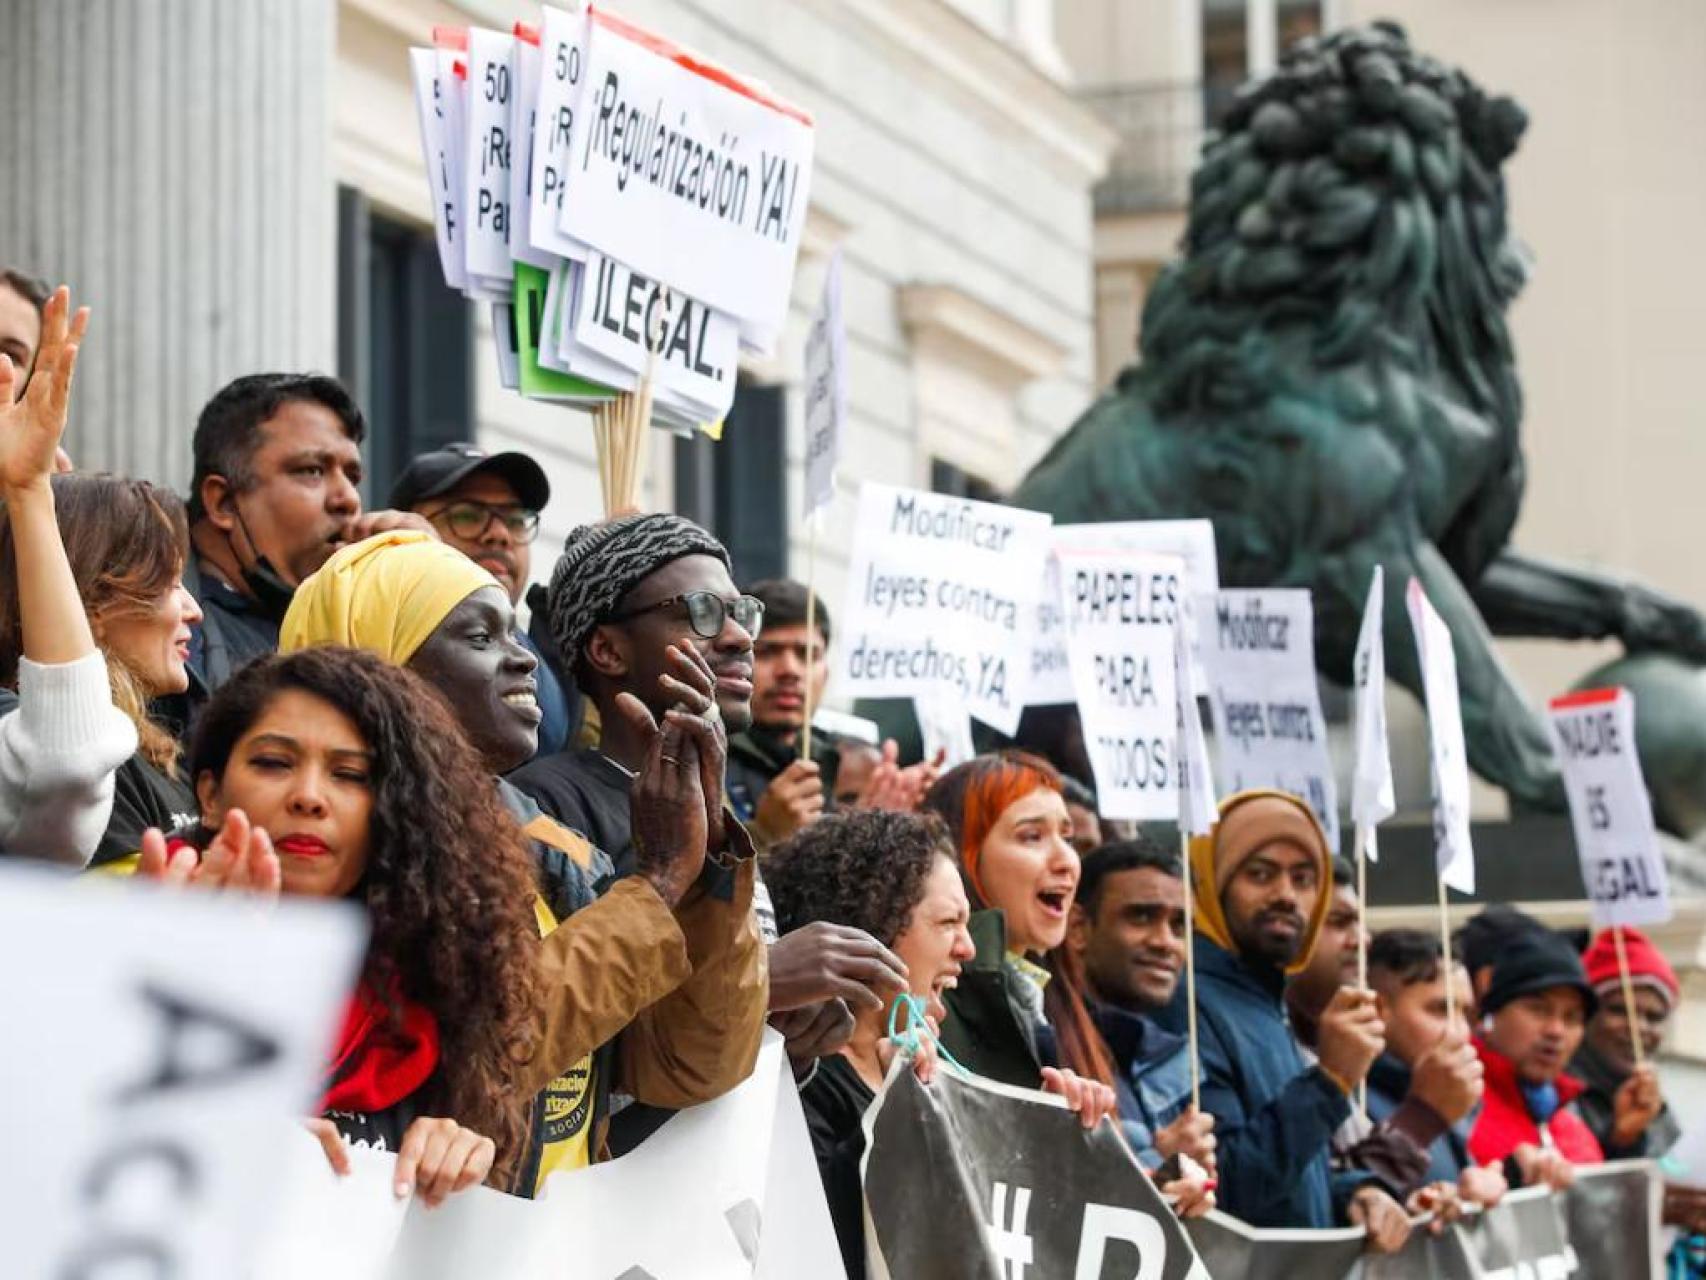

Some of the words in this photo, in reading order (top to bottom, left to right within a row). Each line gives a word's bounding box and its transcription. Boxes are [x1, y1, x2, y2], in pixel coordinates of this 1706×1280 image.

[485, 62, 511, 104] 50
[556, 42, 580, 85] 50
[583, 71, 750, 225] ¡Regularización
[756, 151, 799, 243] YA!
[892, 494, 1014, 552] Modificar
[865, 562, 929, 619] leyes
[936, 580, 1017, 632] contra
